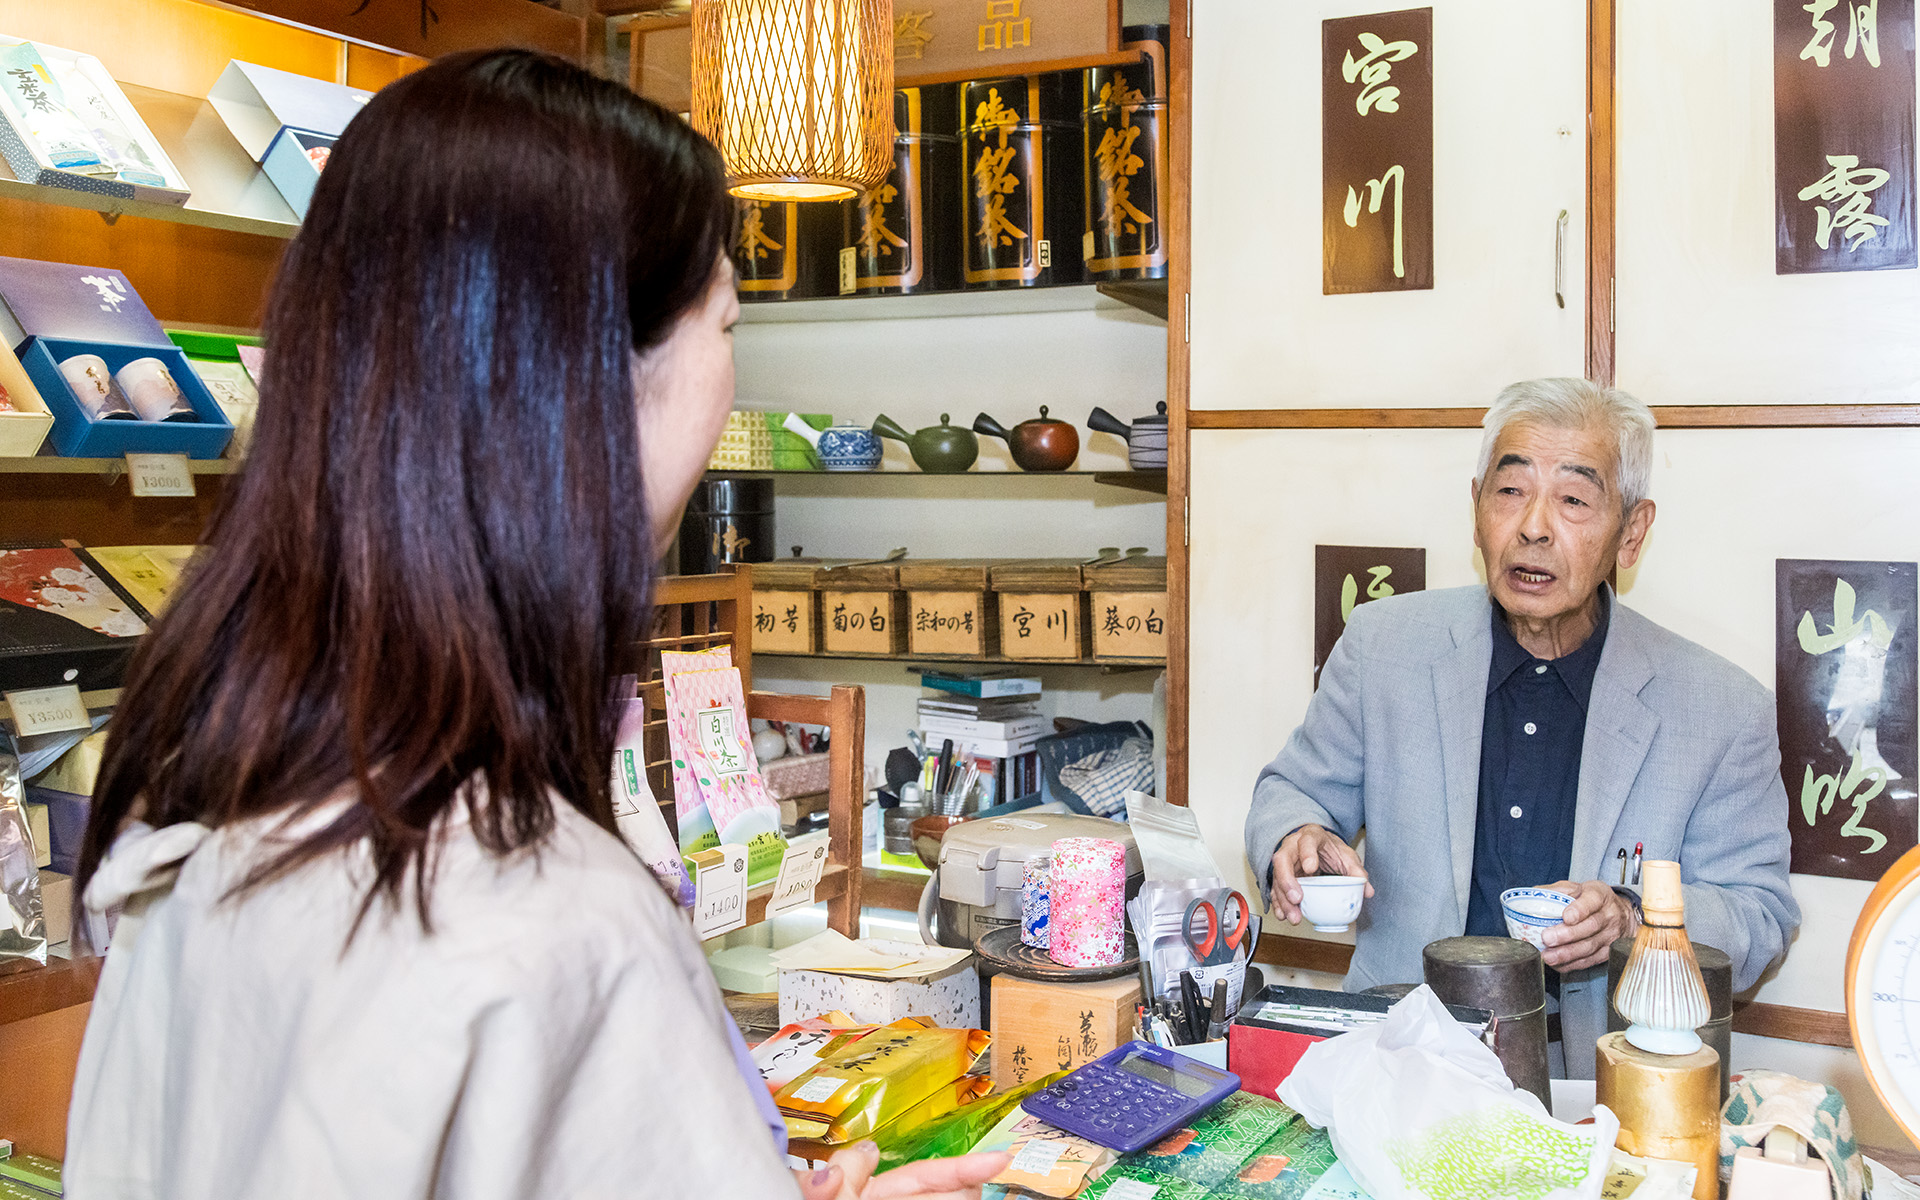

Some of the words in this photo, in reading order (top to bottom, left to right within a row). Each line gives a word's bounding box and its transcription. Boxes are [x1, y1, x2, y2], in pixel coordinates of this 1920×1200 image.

[7, 68, 63, 114] 玄米茶
[1342, 32, 1418, 278] 宮川
[832, 603, 886, 632] 菊の白
[916, 608, 975, 635] 宗和の昔
[1012, 606, 1069, 641] 宮川
[1101, 605, 1164, 637] 葵の白
[710, 715, 738, 768] 白川茶
[704, 894, 739, 920] ¥1400
[1873, 992, 1898, 1003] 300
[1136, 1044, 1163, 1057] CASIO
[1056, 1101, 1071, 1110] 00
